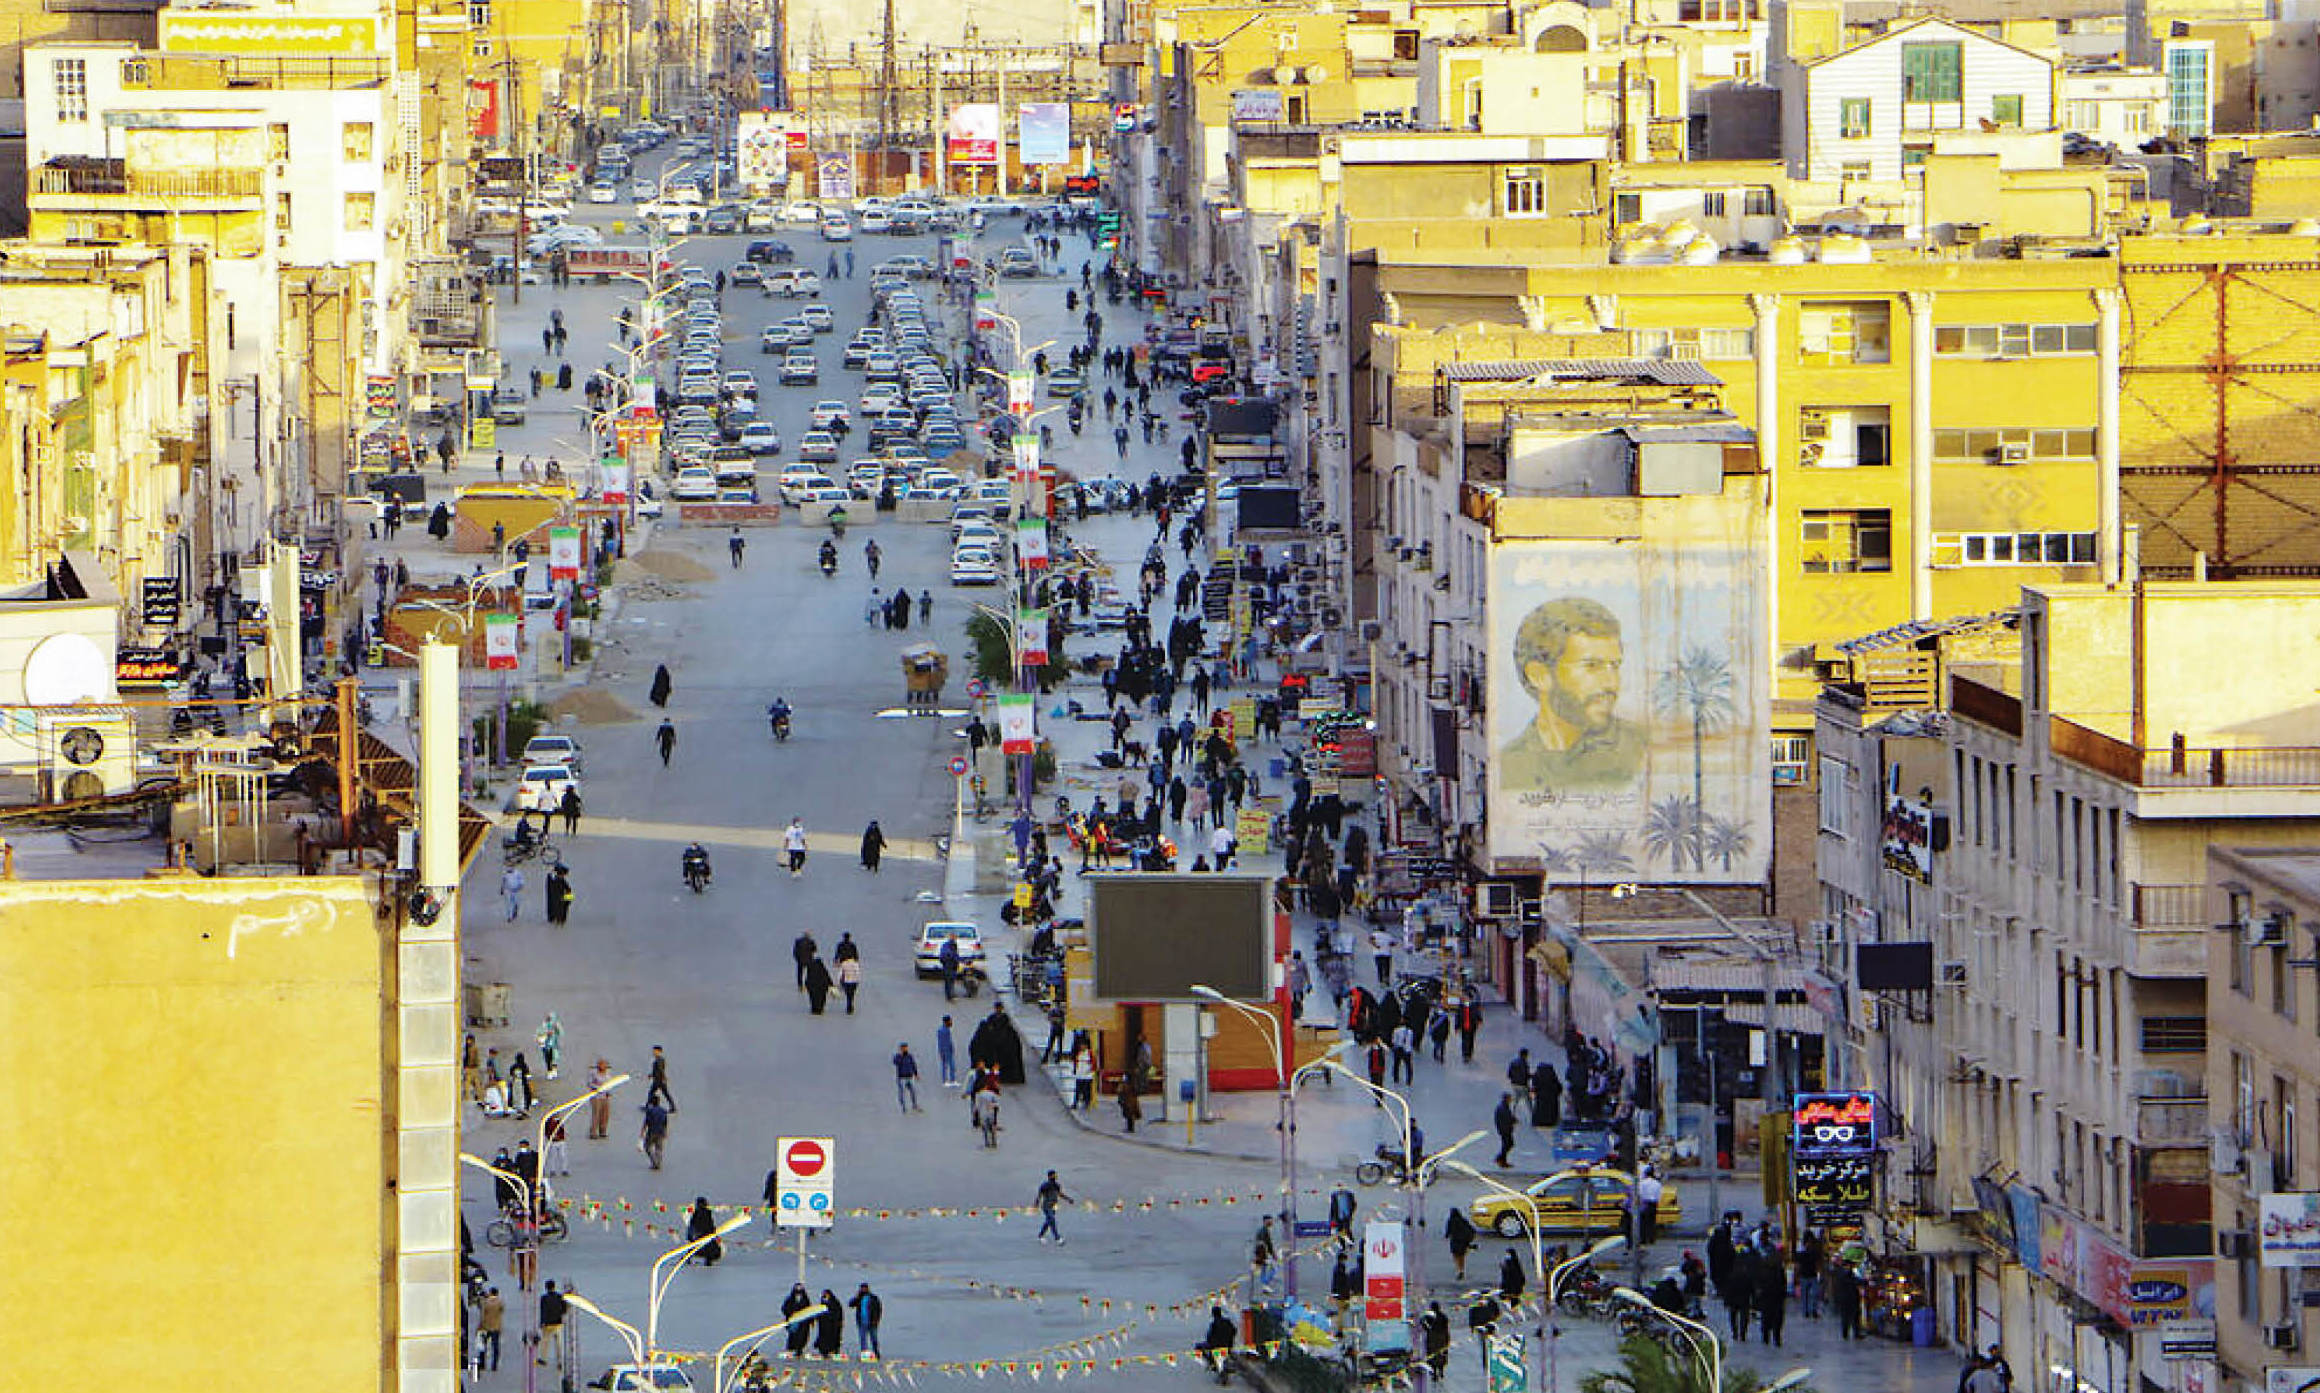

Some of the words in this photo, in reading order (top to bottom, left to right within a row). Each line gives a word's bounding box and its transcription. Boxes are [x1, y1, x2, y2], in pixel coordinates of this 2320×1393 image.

[1797, 1162, 1836, 1181] خرید
[1835, 1160, 1870, 1181] مرکز
[1798, 1185, 1831, 1201] سکه
